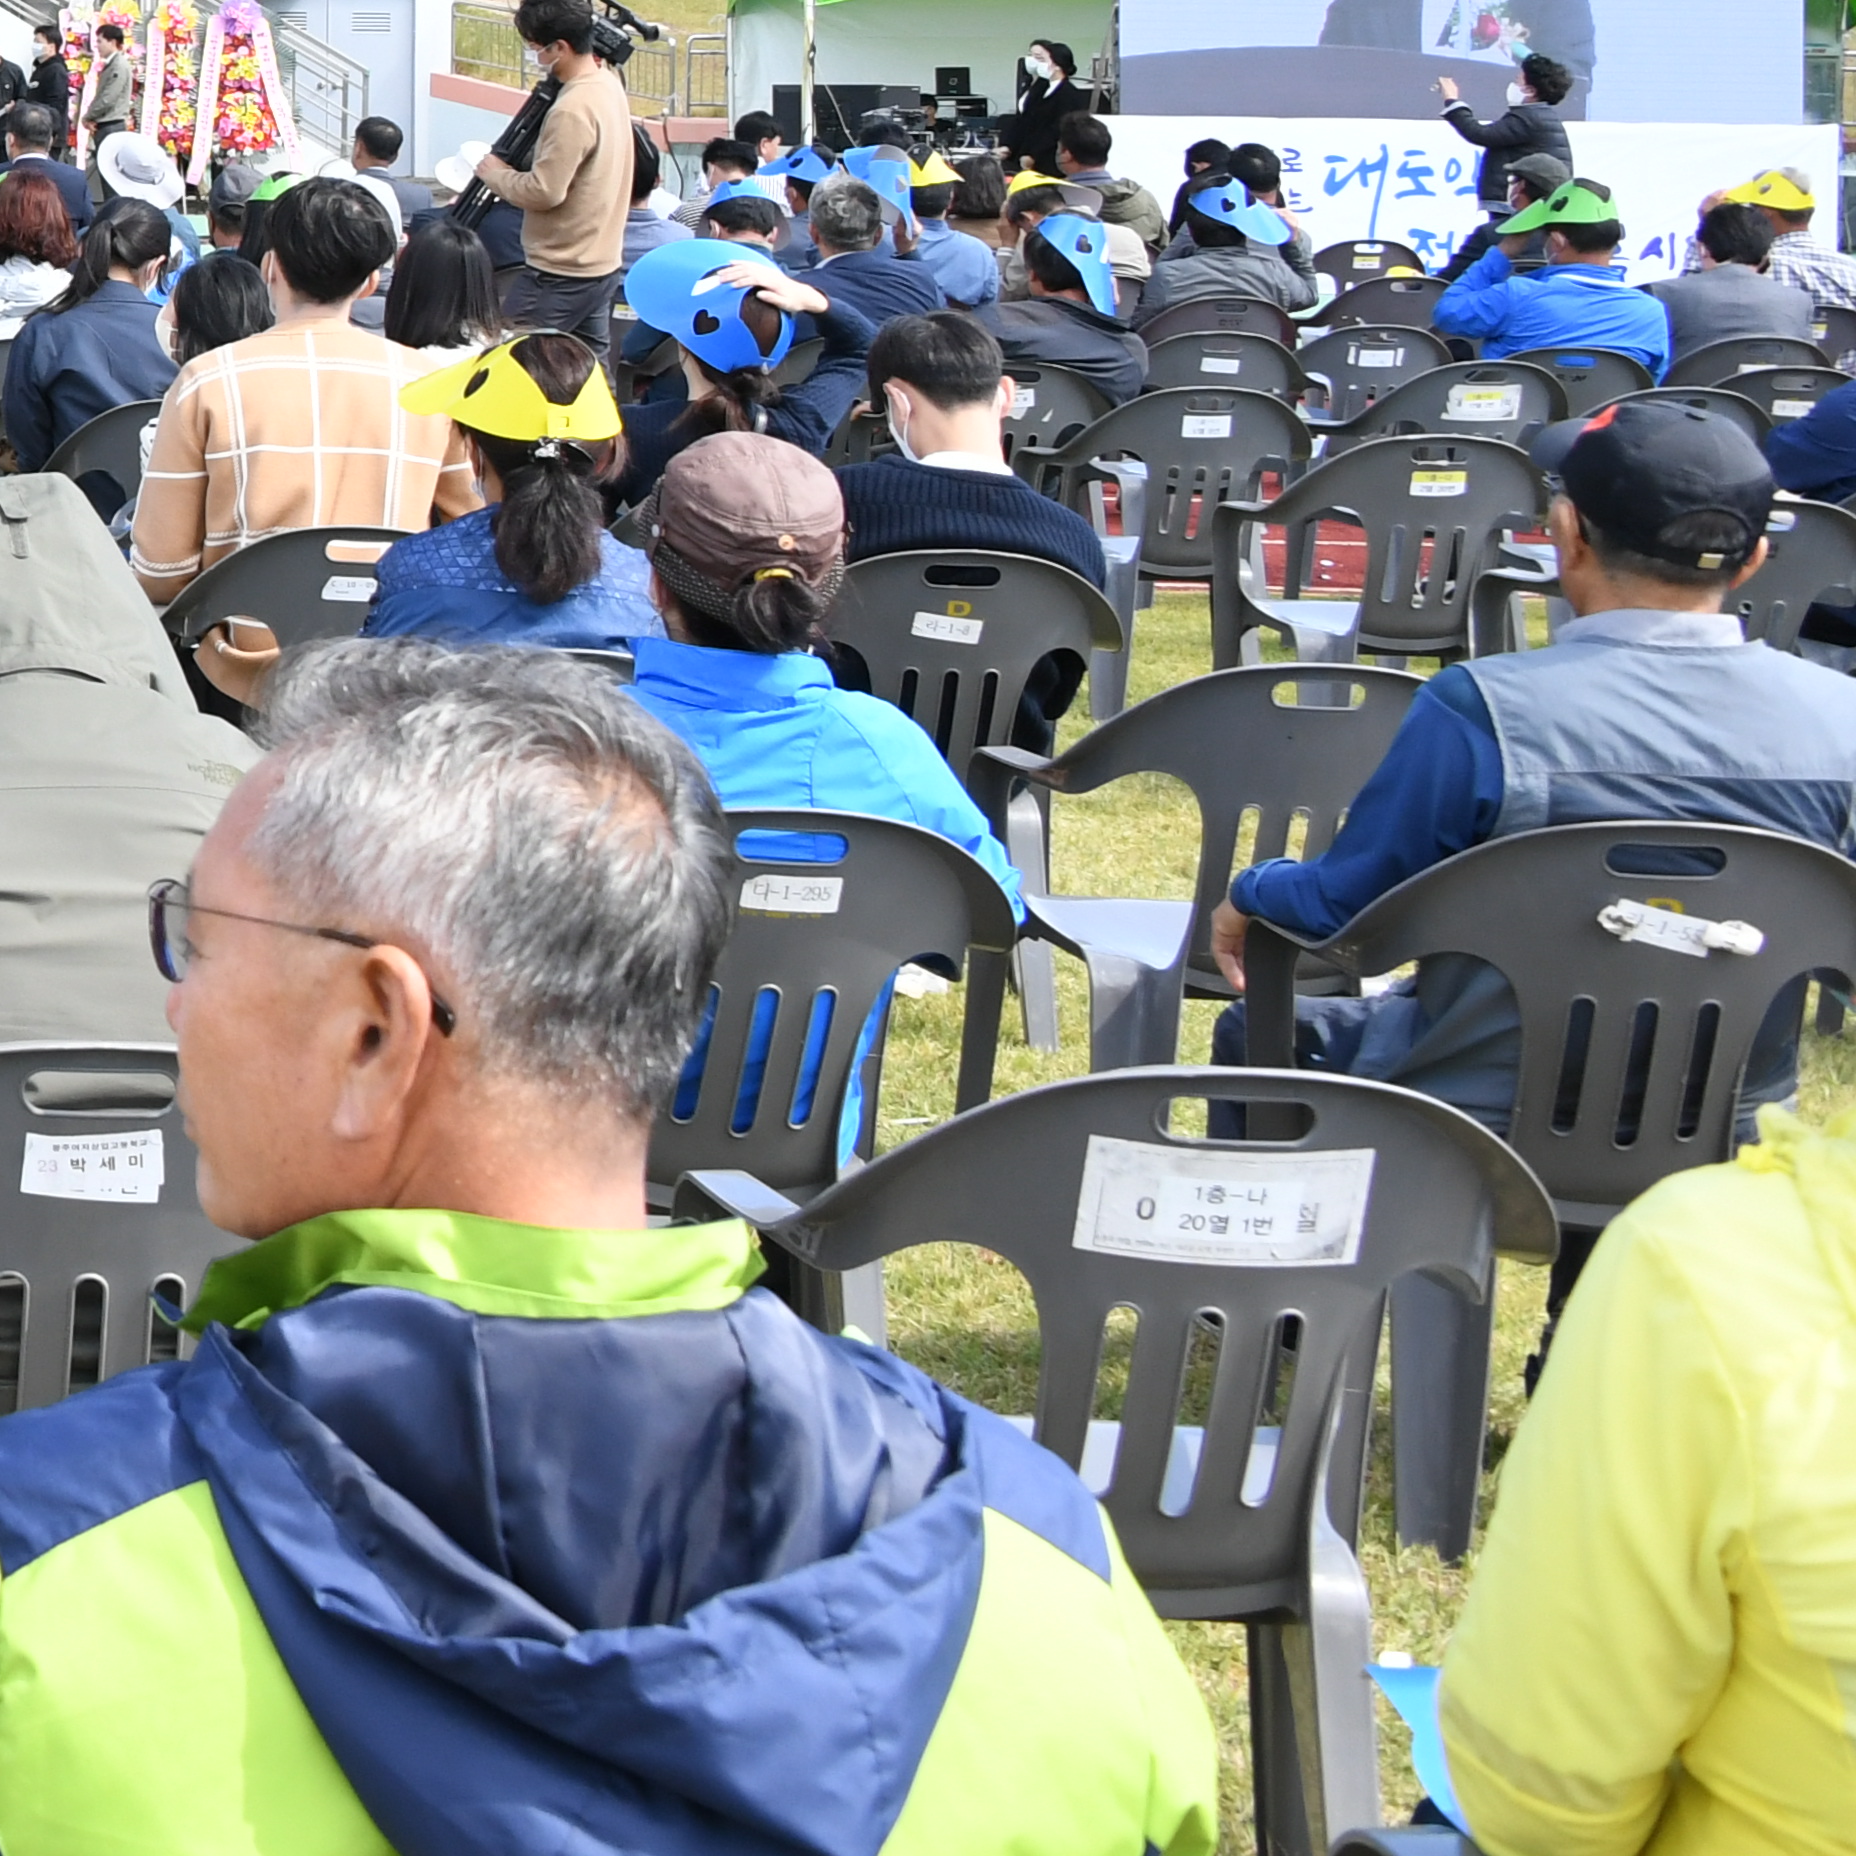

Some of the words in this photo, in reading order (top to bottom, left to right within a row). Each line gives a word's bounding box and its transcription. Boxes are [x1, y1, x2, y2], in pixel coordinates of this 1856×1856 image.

[753, 882, 832, 901] 다-1-295
[37, 1159, 58, 1173] 23
[1194, 1184, 1268, 1204] 1층-나
[1178, 1213, 1229, 1235] 20열
[1242, 1215, 1273, 1236] 1번
